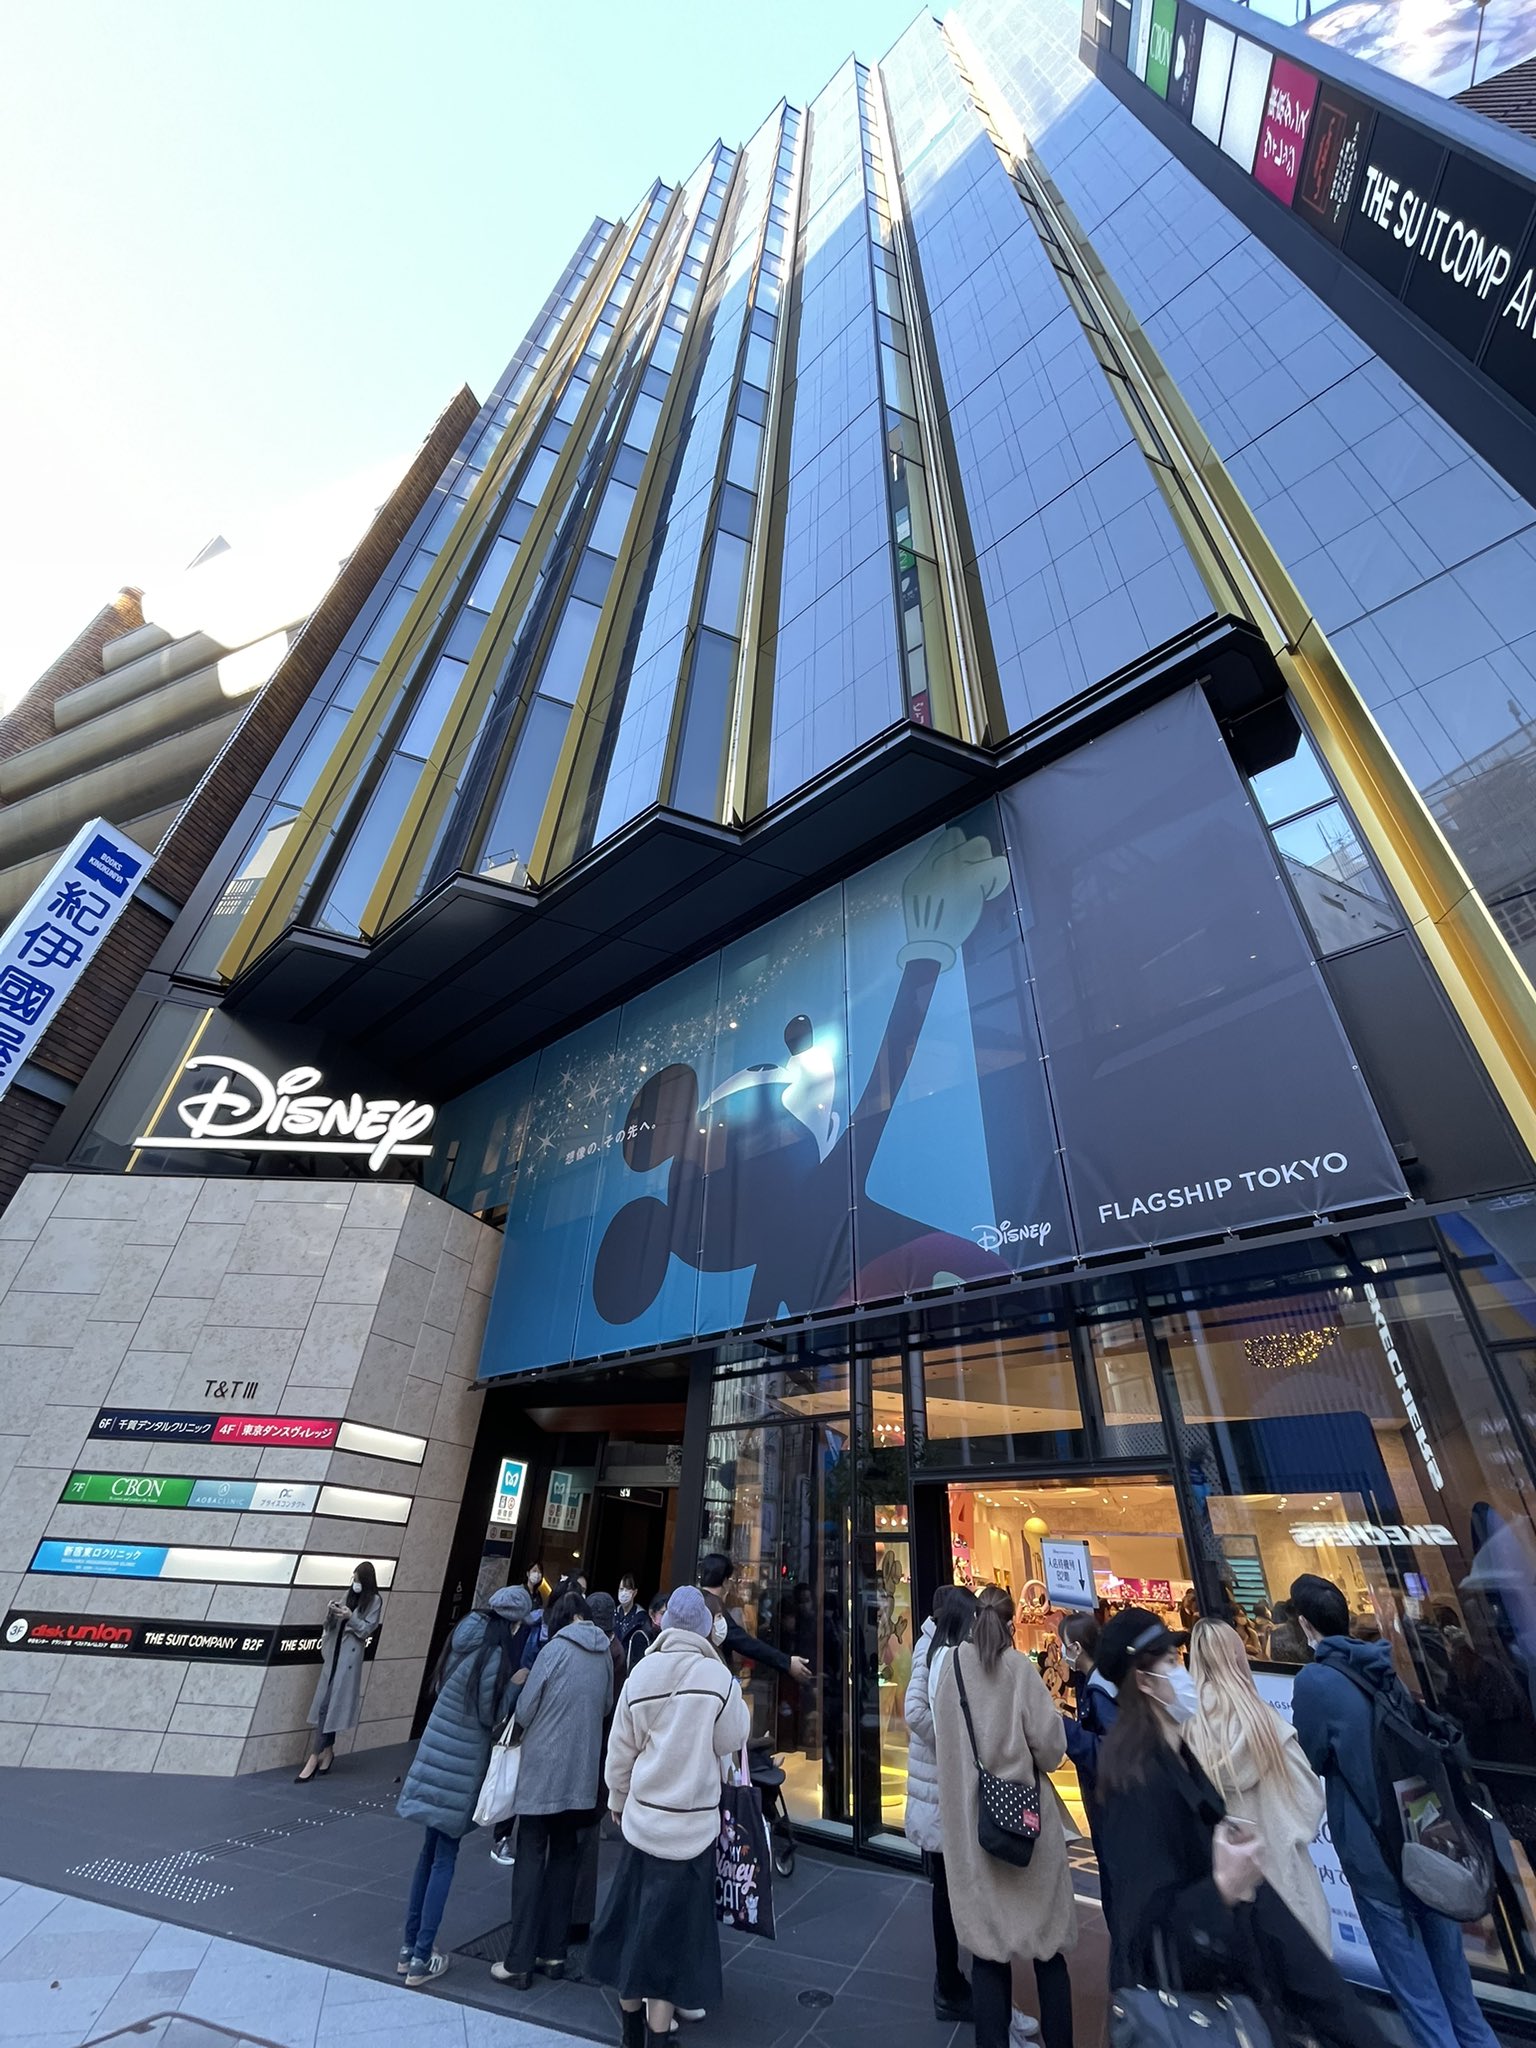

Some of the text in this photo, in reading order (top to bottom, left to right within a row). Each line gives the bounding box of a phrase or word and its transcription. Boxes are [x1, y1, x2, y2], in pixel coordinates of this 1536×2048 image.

[1360, 165, 1399, 230] THE
[1393, 190, 1450, 261] SUIT
[100, 853, 123, 871] BOOKS
[1098, 1152, 1349, 1224] FLAGSHIP TOKYO
[203, 1380, 242, 1398] T&T
[98, 1418, 211, 1434] 6F 千賀デンタルクリニック
[219, 1424, 333, 1439] 4F 東京ダンスヴィレッジ
[71, 1482, 86, 1493] 7F
[10, 1622, 132, 1641] 3F disk union
[144, 1632, 264, 1651] THE SUIT COMPANY B2F
[280, 1639, 298, 1652] THE
[297, 1639, 317, 1651] SUIT
